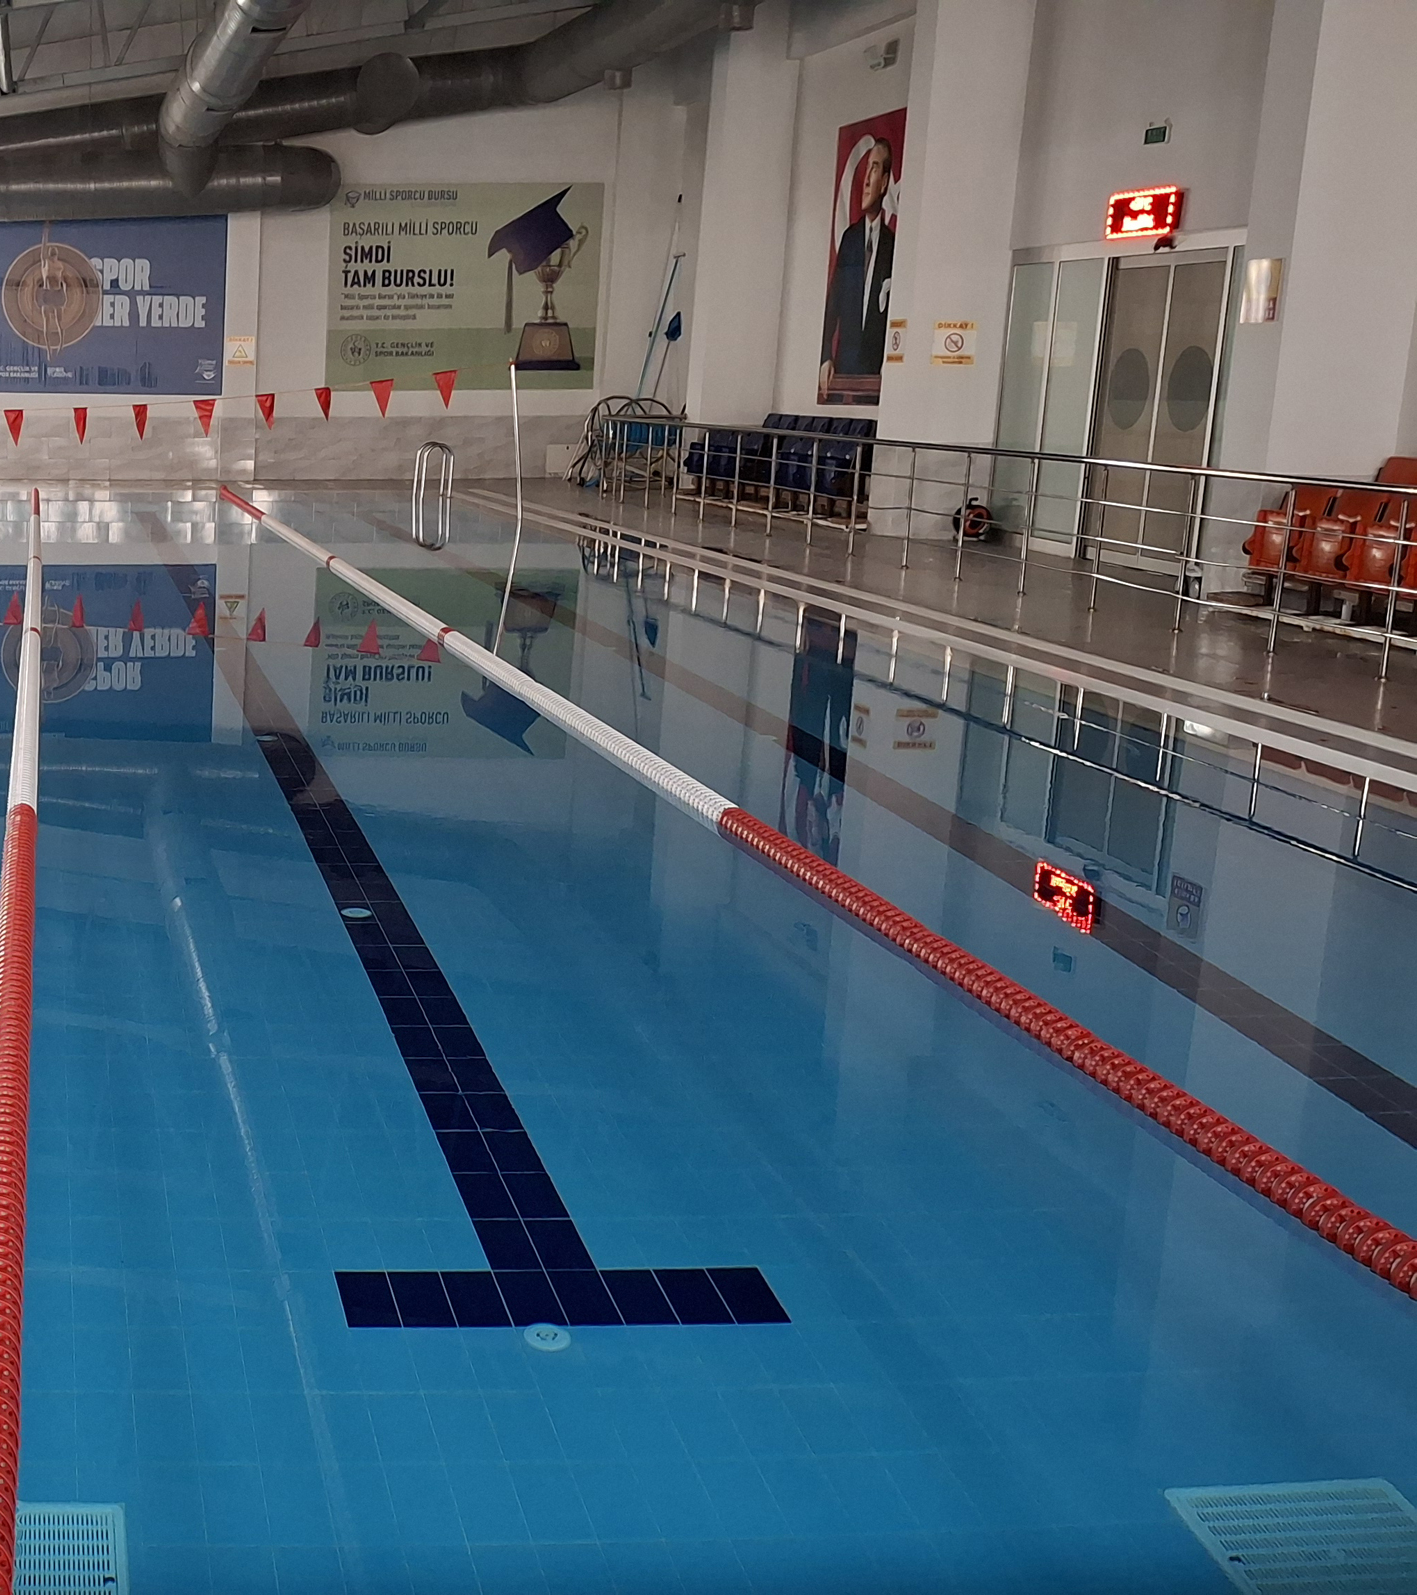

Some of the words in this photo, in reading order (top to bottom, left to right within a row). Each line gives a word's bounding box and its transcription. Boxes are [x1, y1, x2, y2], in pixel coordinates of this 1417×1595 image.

[363, 188, 387, 201] MİLLİ
[389, 189, 425, 201] SPORCU
[428, 189, 458, 201] BURSU
[342, 220, 394, 240] BAŞARILI
[398, 218, 428, 236] MİLLİ
[431, 220, 478, 236] SPORCU
[342, 241, 391, 268] ŞİMDİ
[341, 268, 376, 288] TAM
[381, 268, 455, 288] BURSLU!
[136, 295, 207, 328] YERDE
